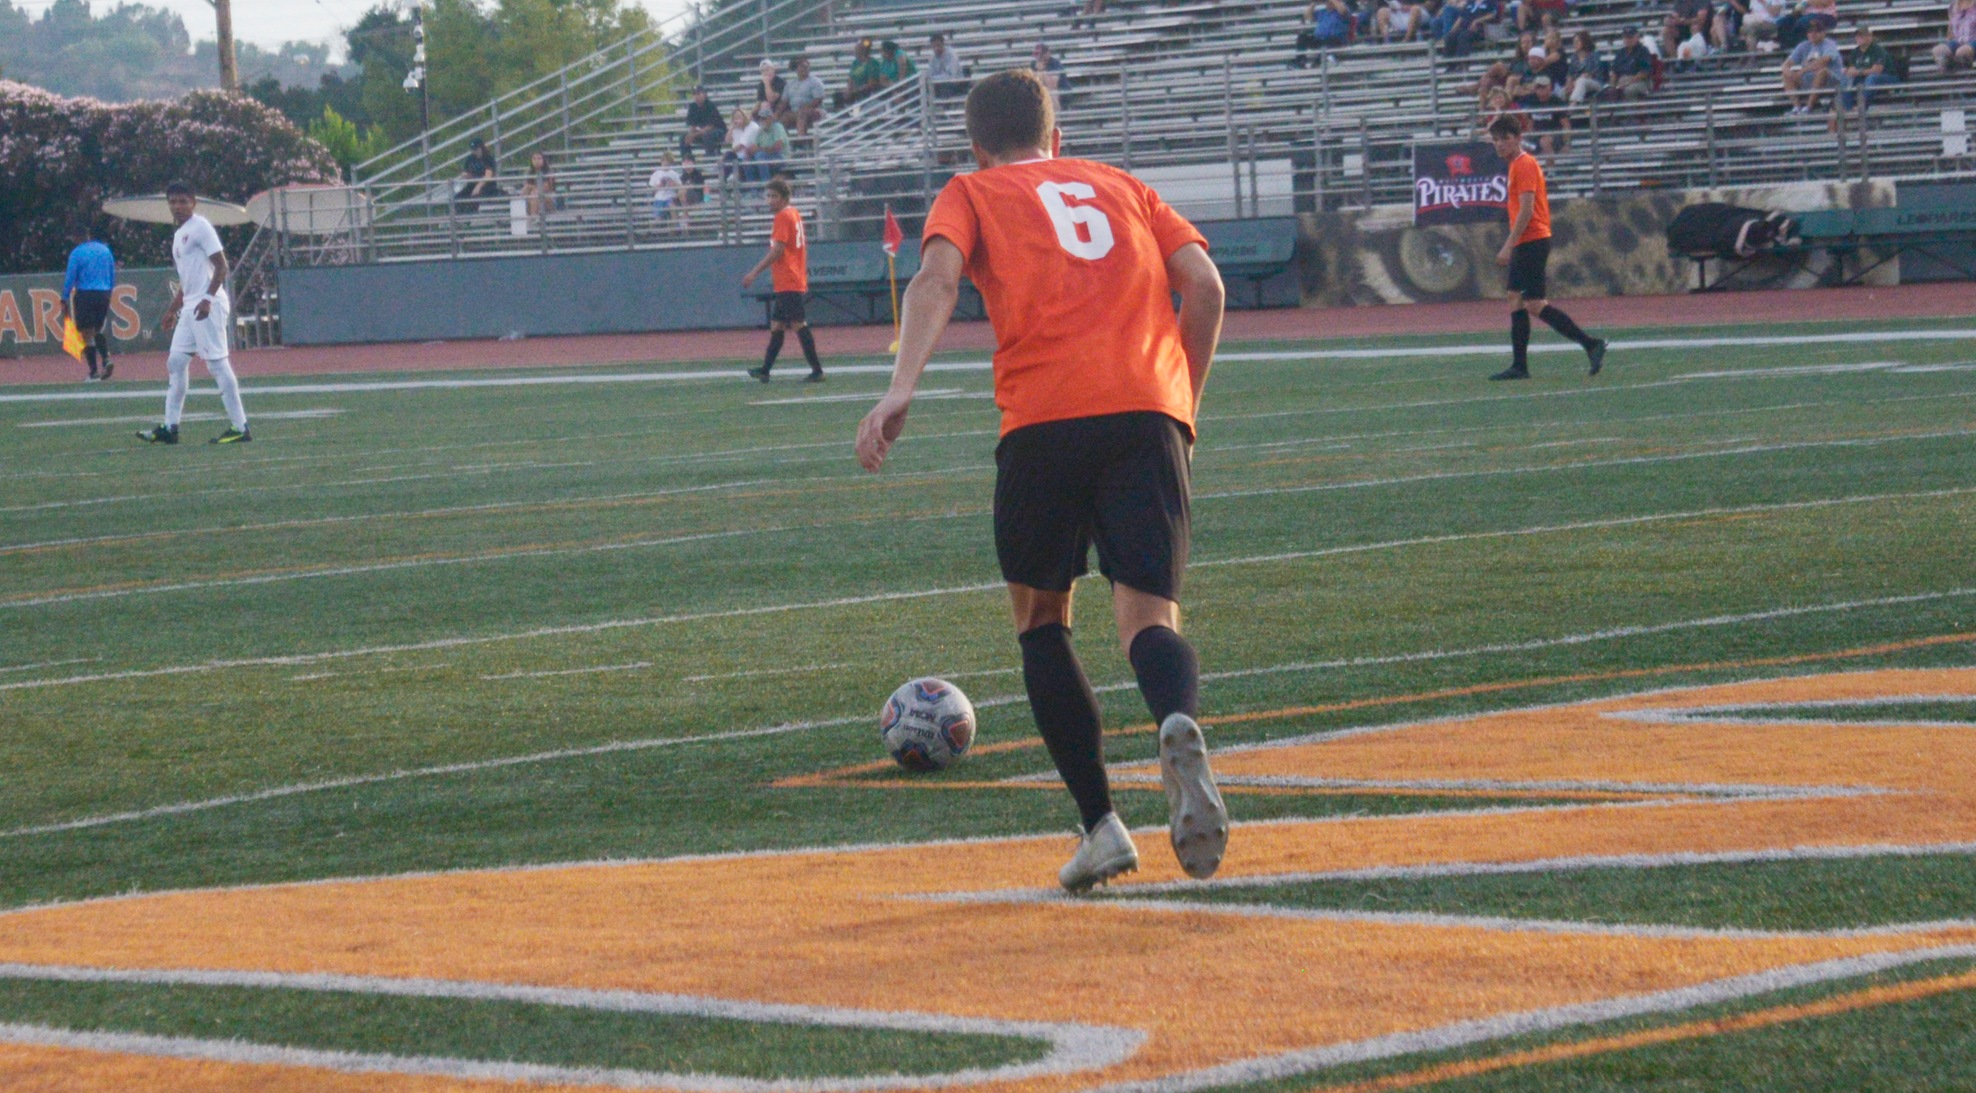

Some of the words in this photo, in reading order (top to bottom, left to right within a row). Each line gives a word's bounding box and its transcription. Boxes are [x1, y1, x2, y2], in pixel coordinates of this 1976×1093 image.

[1036, 181, 1115, 261] 6
[1416, 175, 1507, 208] PIRATES
[0, 284, 141, 345] ARS
